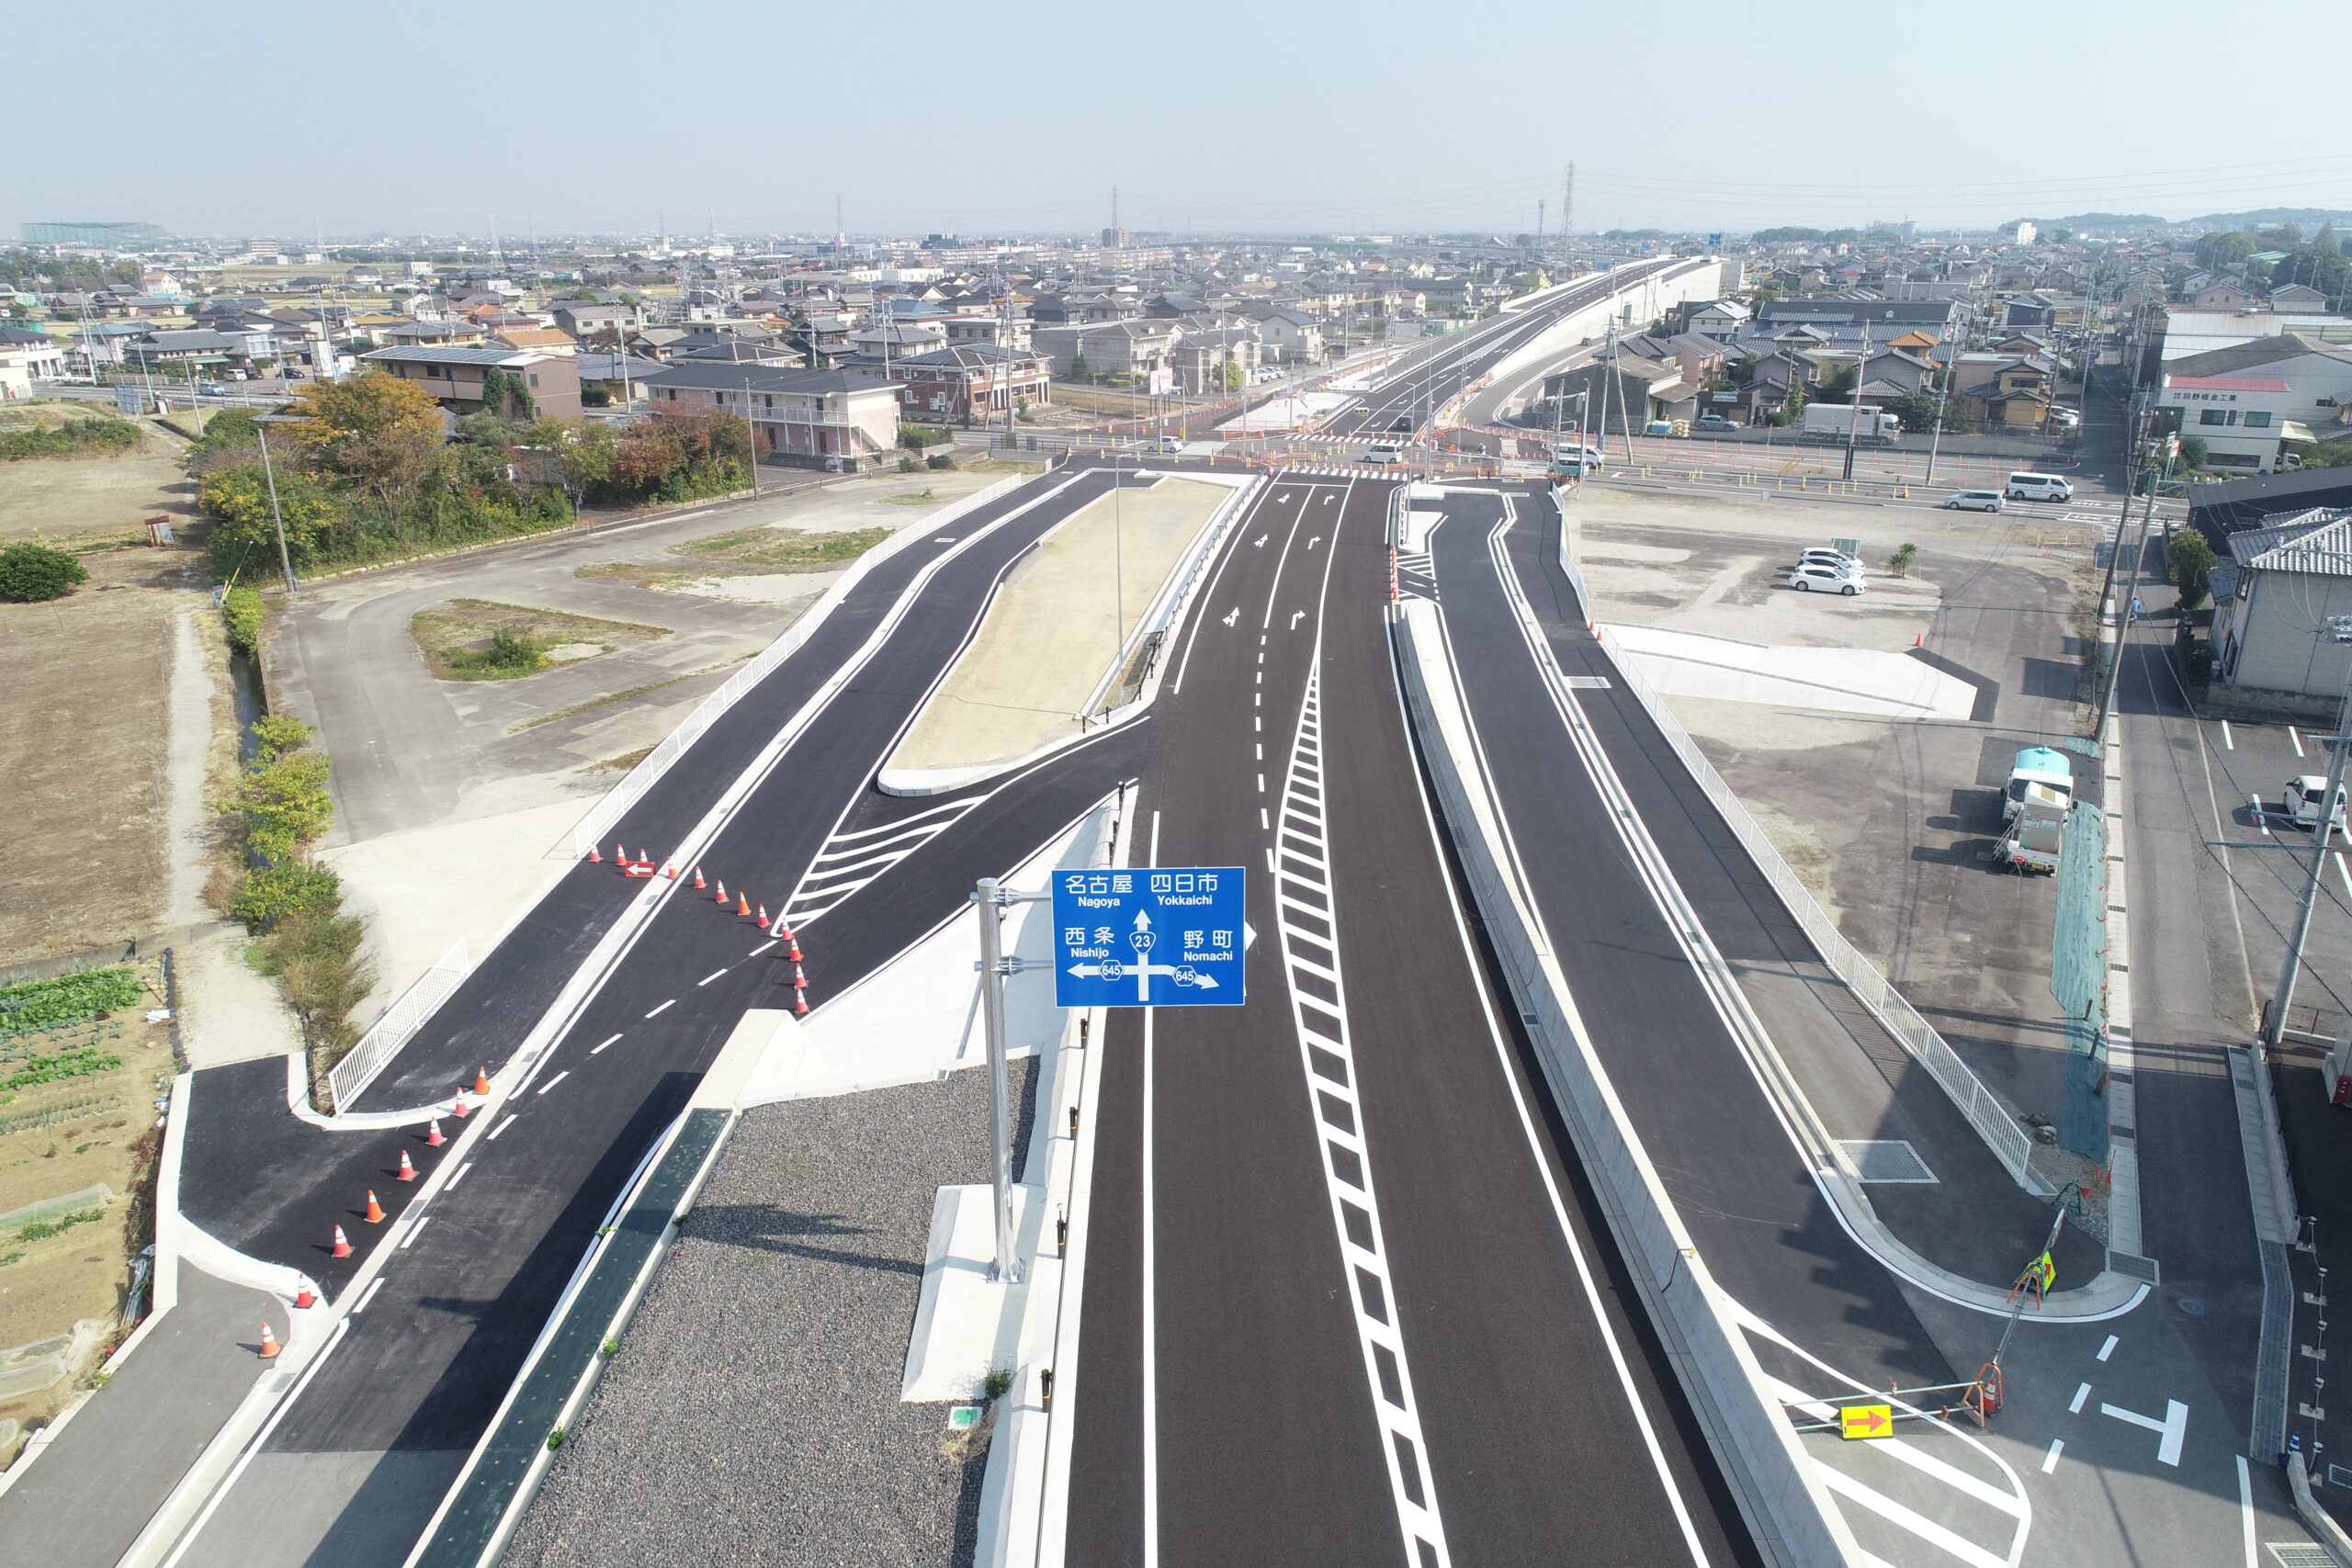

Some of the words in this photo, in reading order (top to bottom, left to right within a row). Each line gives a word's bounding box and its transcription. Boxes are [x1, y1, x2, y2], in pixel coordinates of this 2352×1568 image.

[1066, 874, 1133, 894] 名古屋
[1151, 873, 1218, 893] 四日市
[1078, 897, 1121, 908] Nagoya
[1157, 895, 1213, 906] Yokkaichi
[1065, 926, 1114, 945] 西条
[1135, 935, 1150, 947] 23
[1183, 930, 1233, 949] 野町
[1070, 947, 1110, 959] Nishijo
[1183, 951, 1233, 962] Nomachi
[1102, 965, 1121, 976] 645
[1176, 971, 1194, 981] 645
